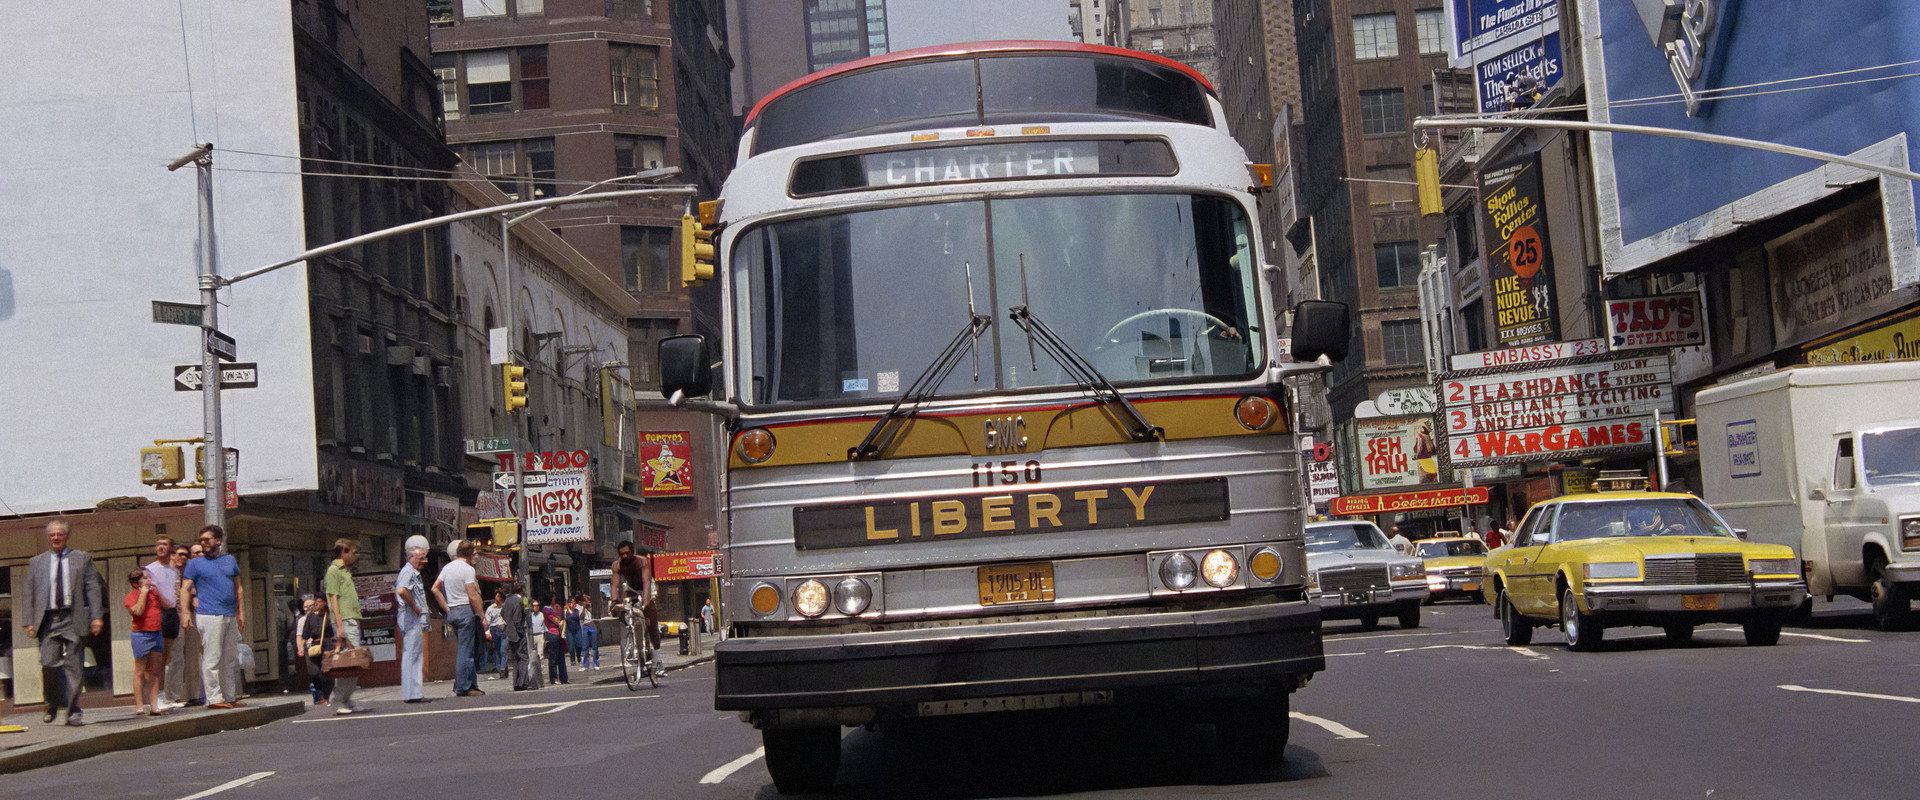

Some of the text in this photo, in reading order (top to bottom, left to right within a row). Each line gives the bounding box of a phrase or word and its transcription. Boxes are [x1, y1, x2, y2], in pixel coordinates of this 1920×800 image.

[1497, 2, 1525, 24] Finest
[1482, 57, 1502, 79] TOM
[1502, 45, 1536, 72] SELLECK
[1483, 79, 1505, 99] The
[887, 148, 1074, 185] CHARTER
[1501, 204, 1538, 241] Center
[1514, 238, 1537, 267] 25
[1495, 275, 1519, 294] LIVE
[1497, 289, 1528, 311] NUDE
[1499, 304, 1536, 327] REVUE
[1610, 297, 1695, 334] TAD'S
[1627, 331, 1684, 346] STEAKS
[1483, 344, 1564, 366] EMBASSY
[1613, 359, 1649, 371] DOLBY
[1448, 382, 1464, 402] 2
[1469, 370, 1611, 402] FLASHDANCE
[1616, 373, 1656, 386] STEREO
[1452, 385, 1661, 430] 3 BRILLIANT EXCITING
[1474, 416, 1508, 433] AND
[1511, 410, 1567, 429] FUNNY
[984, 416, 1028, 452] GMC
[541, 449, 589, 470] ZOO
[1454, 440, 1471, 458] 4
[971, 460, 1042, 488] 1150
[508, 488, 584, 519] SINGERS
[865, 485, 1157, 541] LIBERTY
